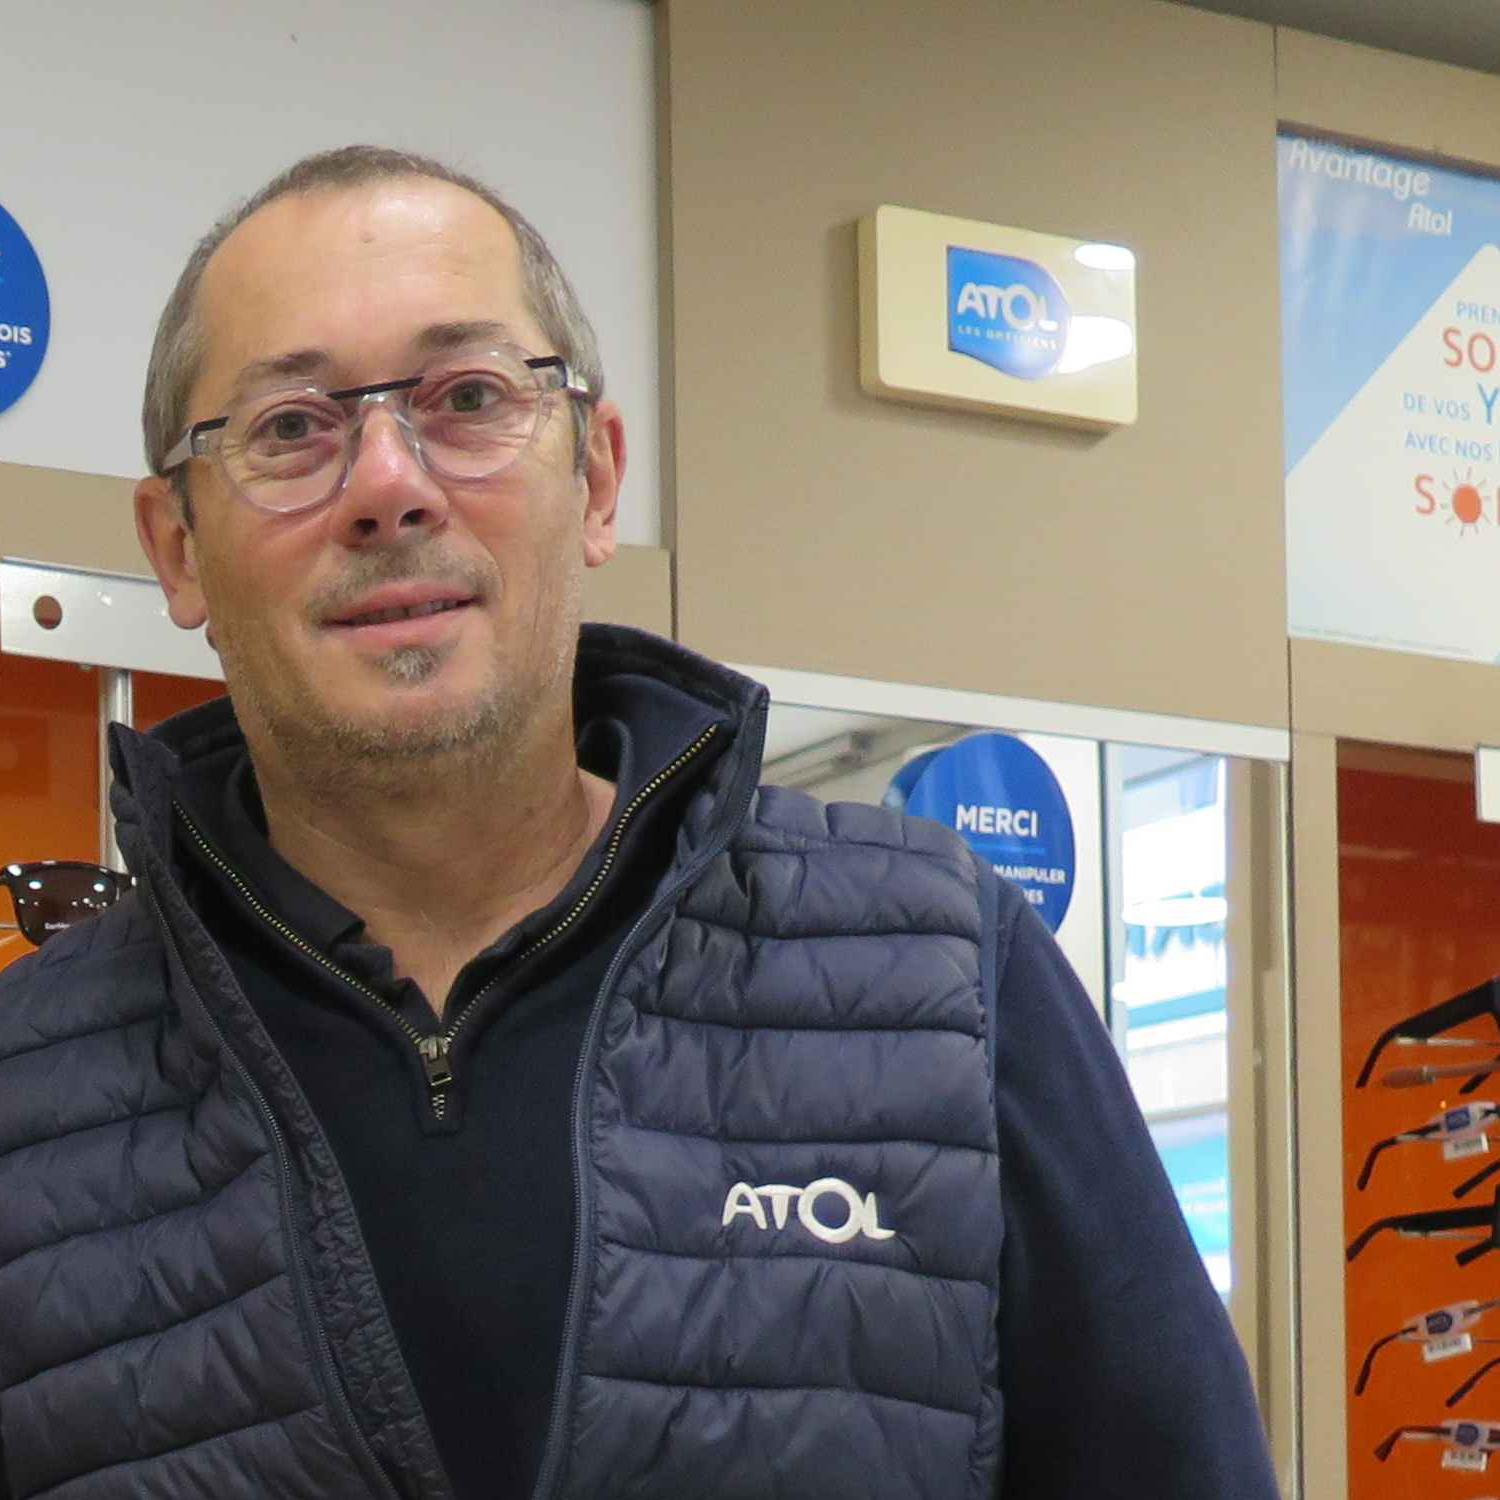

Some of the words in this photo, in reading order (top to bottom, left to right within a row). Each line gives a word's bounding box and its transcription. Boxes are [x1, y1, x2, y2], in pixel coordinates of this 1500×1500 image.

[1289, 139, 1431, 201] Avantage
[957, 282, 1059, 332] ATOL
[1403, 392, 1427, 413] DE
[1434, 399, 1471, 421] VOS
[1405, 431, 1451, 455] AVEC
[1454, 440, 1493, 461] NOS
[955, 804, 1038, 838] MERCI
[992, 863, 1066, 885] MANIPULER
[721, 1177, 896, 1244] ATOL
